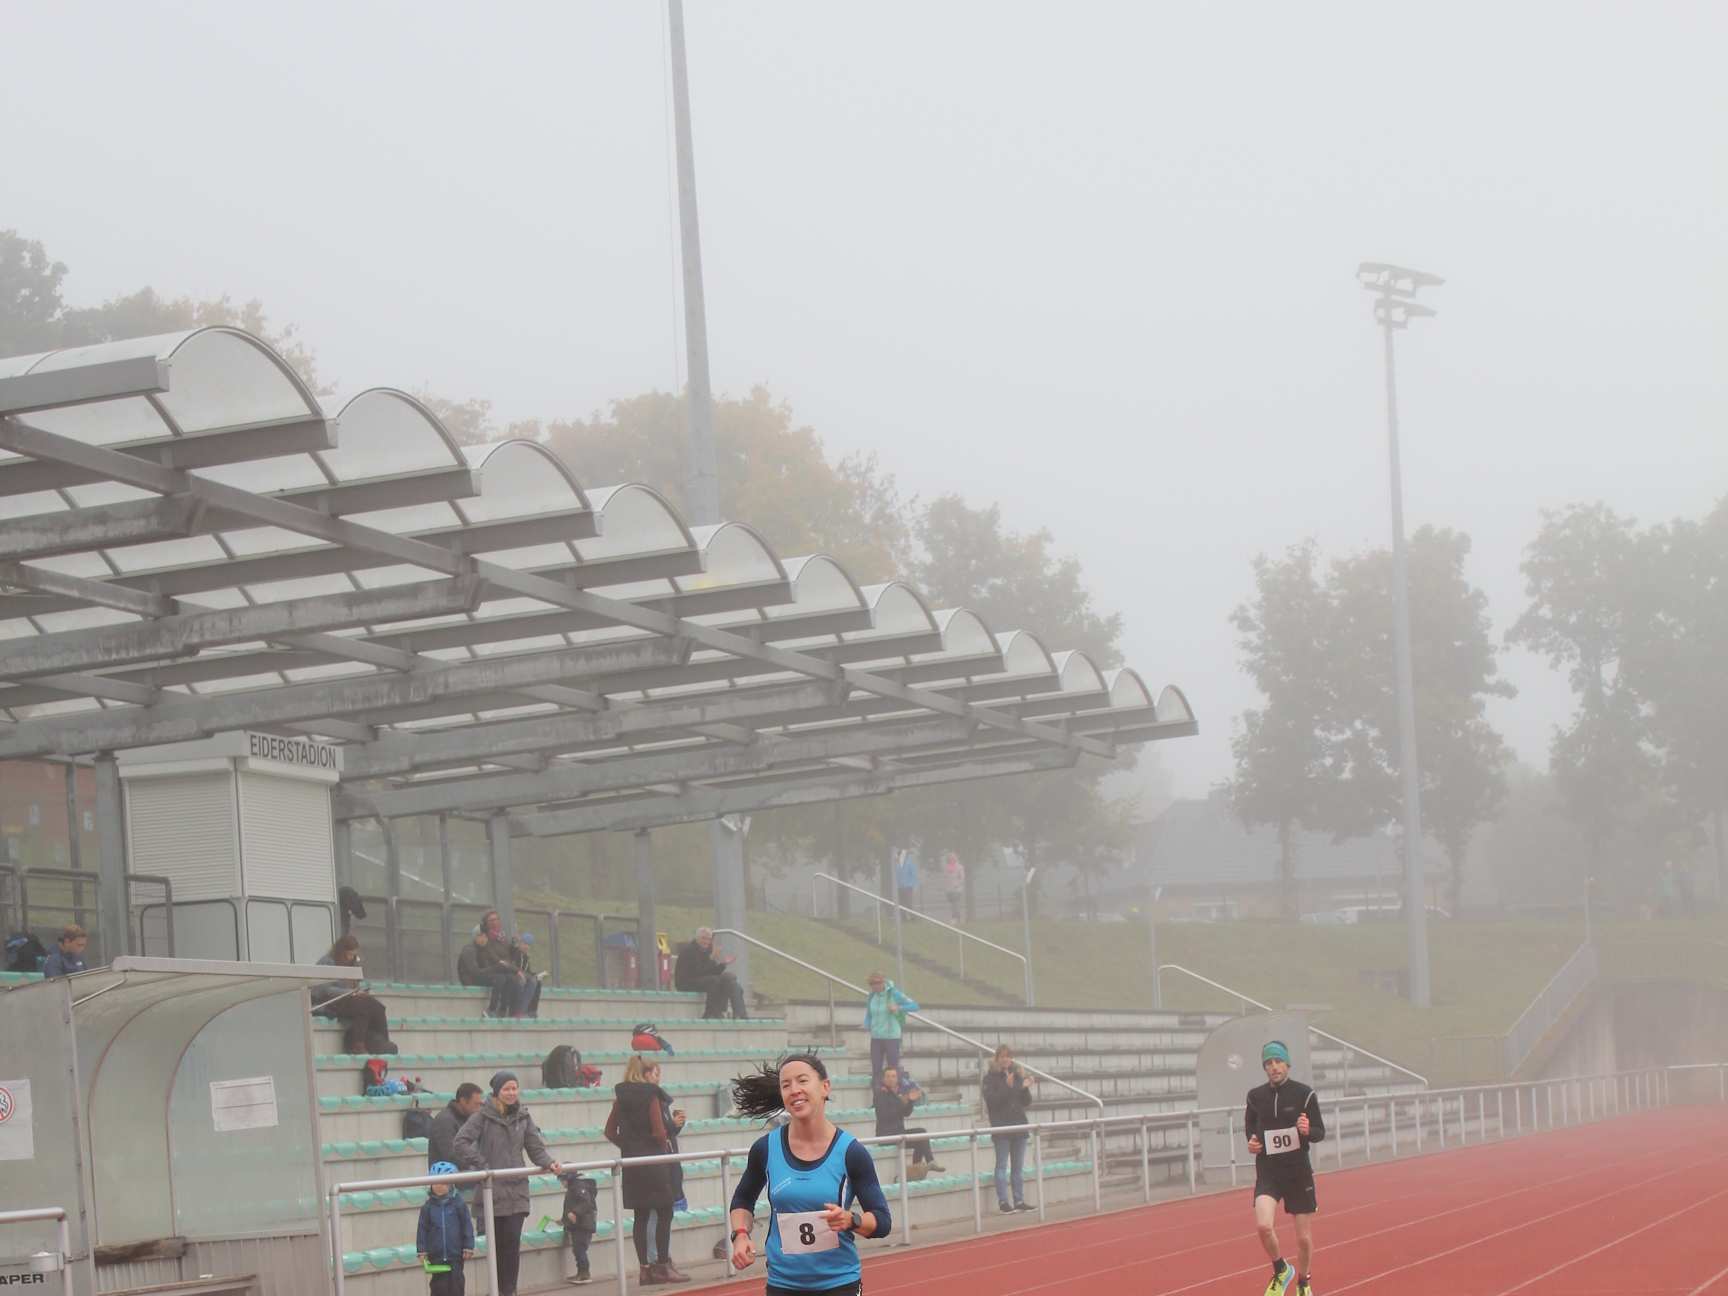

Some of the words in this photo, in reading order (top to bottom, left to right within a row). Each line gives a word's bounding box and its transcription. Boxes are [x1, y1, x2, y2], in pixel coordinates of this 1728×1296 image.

[249, 734, 336, 769] EIDERSTADION
[1272, 1134, 1292, 1149] 90
[799, 1222, 816, 1246] 8
